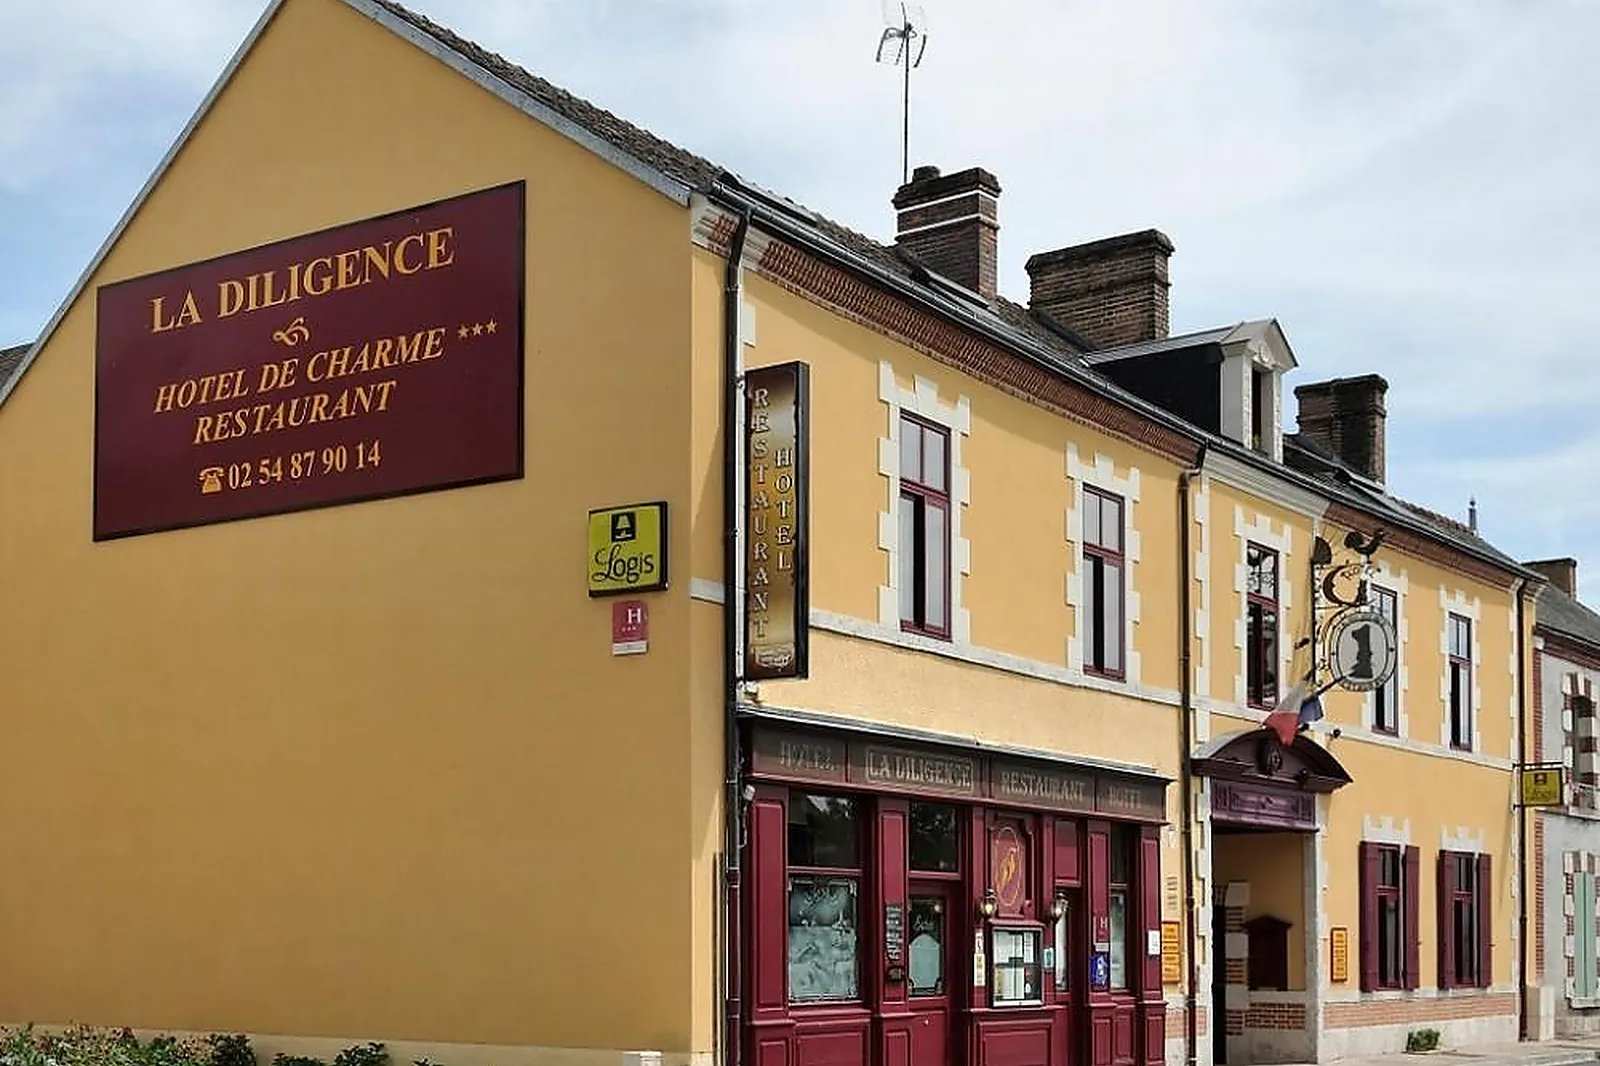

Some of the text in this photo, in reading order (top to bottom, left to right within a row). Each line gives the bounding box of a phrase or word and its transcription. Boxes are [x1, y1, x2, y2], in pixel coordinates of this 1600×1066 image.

[152, 226, 455, 333] LA DILIGENCE
[154, 327, 447, 413] HOTEL DE CHARME
[192, 380, 397, 445] RESTAURANT
[228, 440, 382, 491] 02 54 87 90 14
[752, 387, 771, 639] RESTAURANT
[773, 447, 794, 573] HOTEL
[591, 543, 655, 584] Logis
[627, 607, 642, 624] H
[869, 751, 891, 779] LA
[1000, 771, 1086, 802] RESTAURANT
